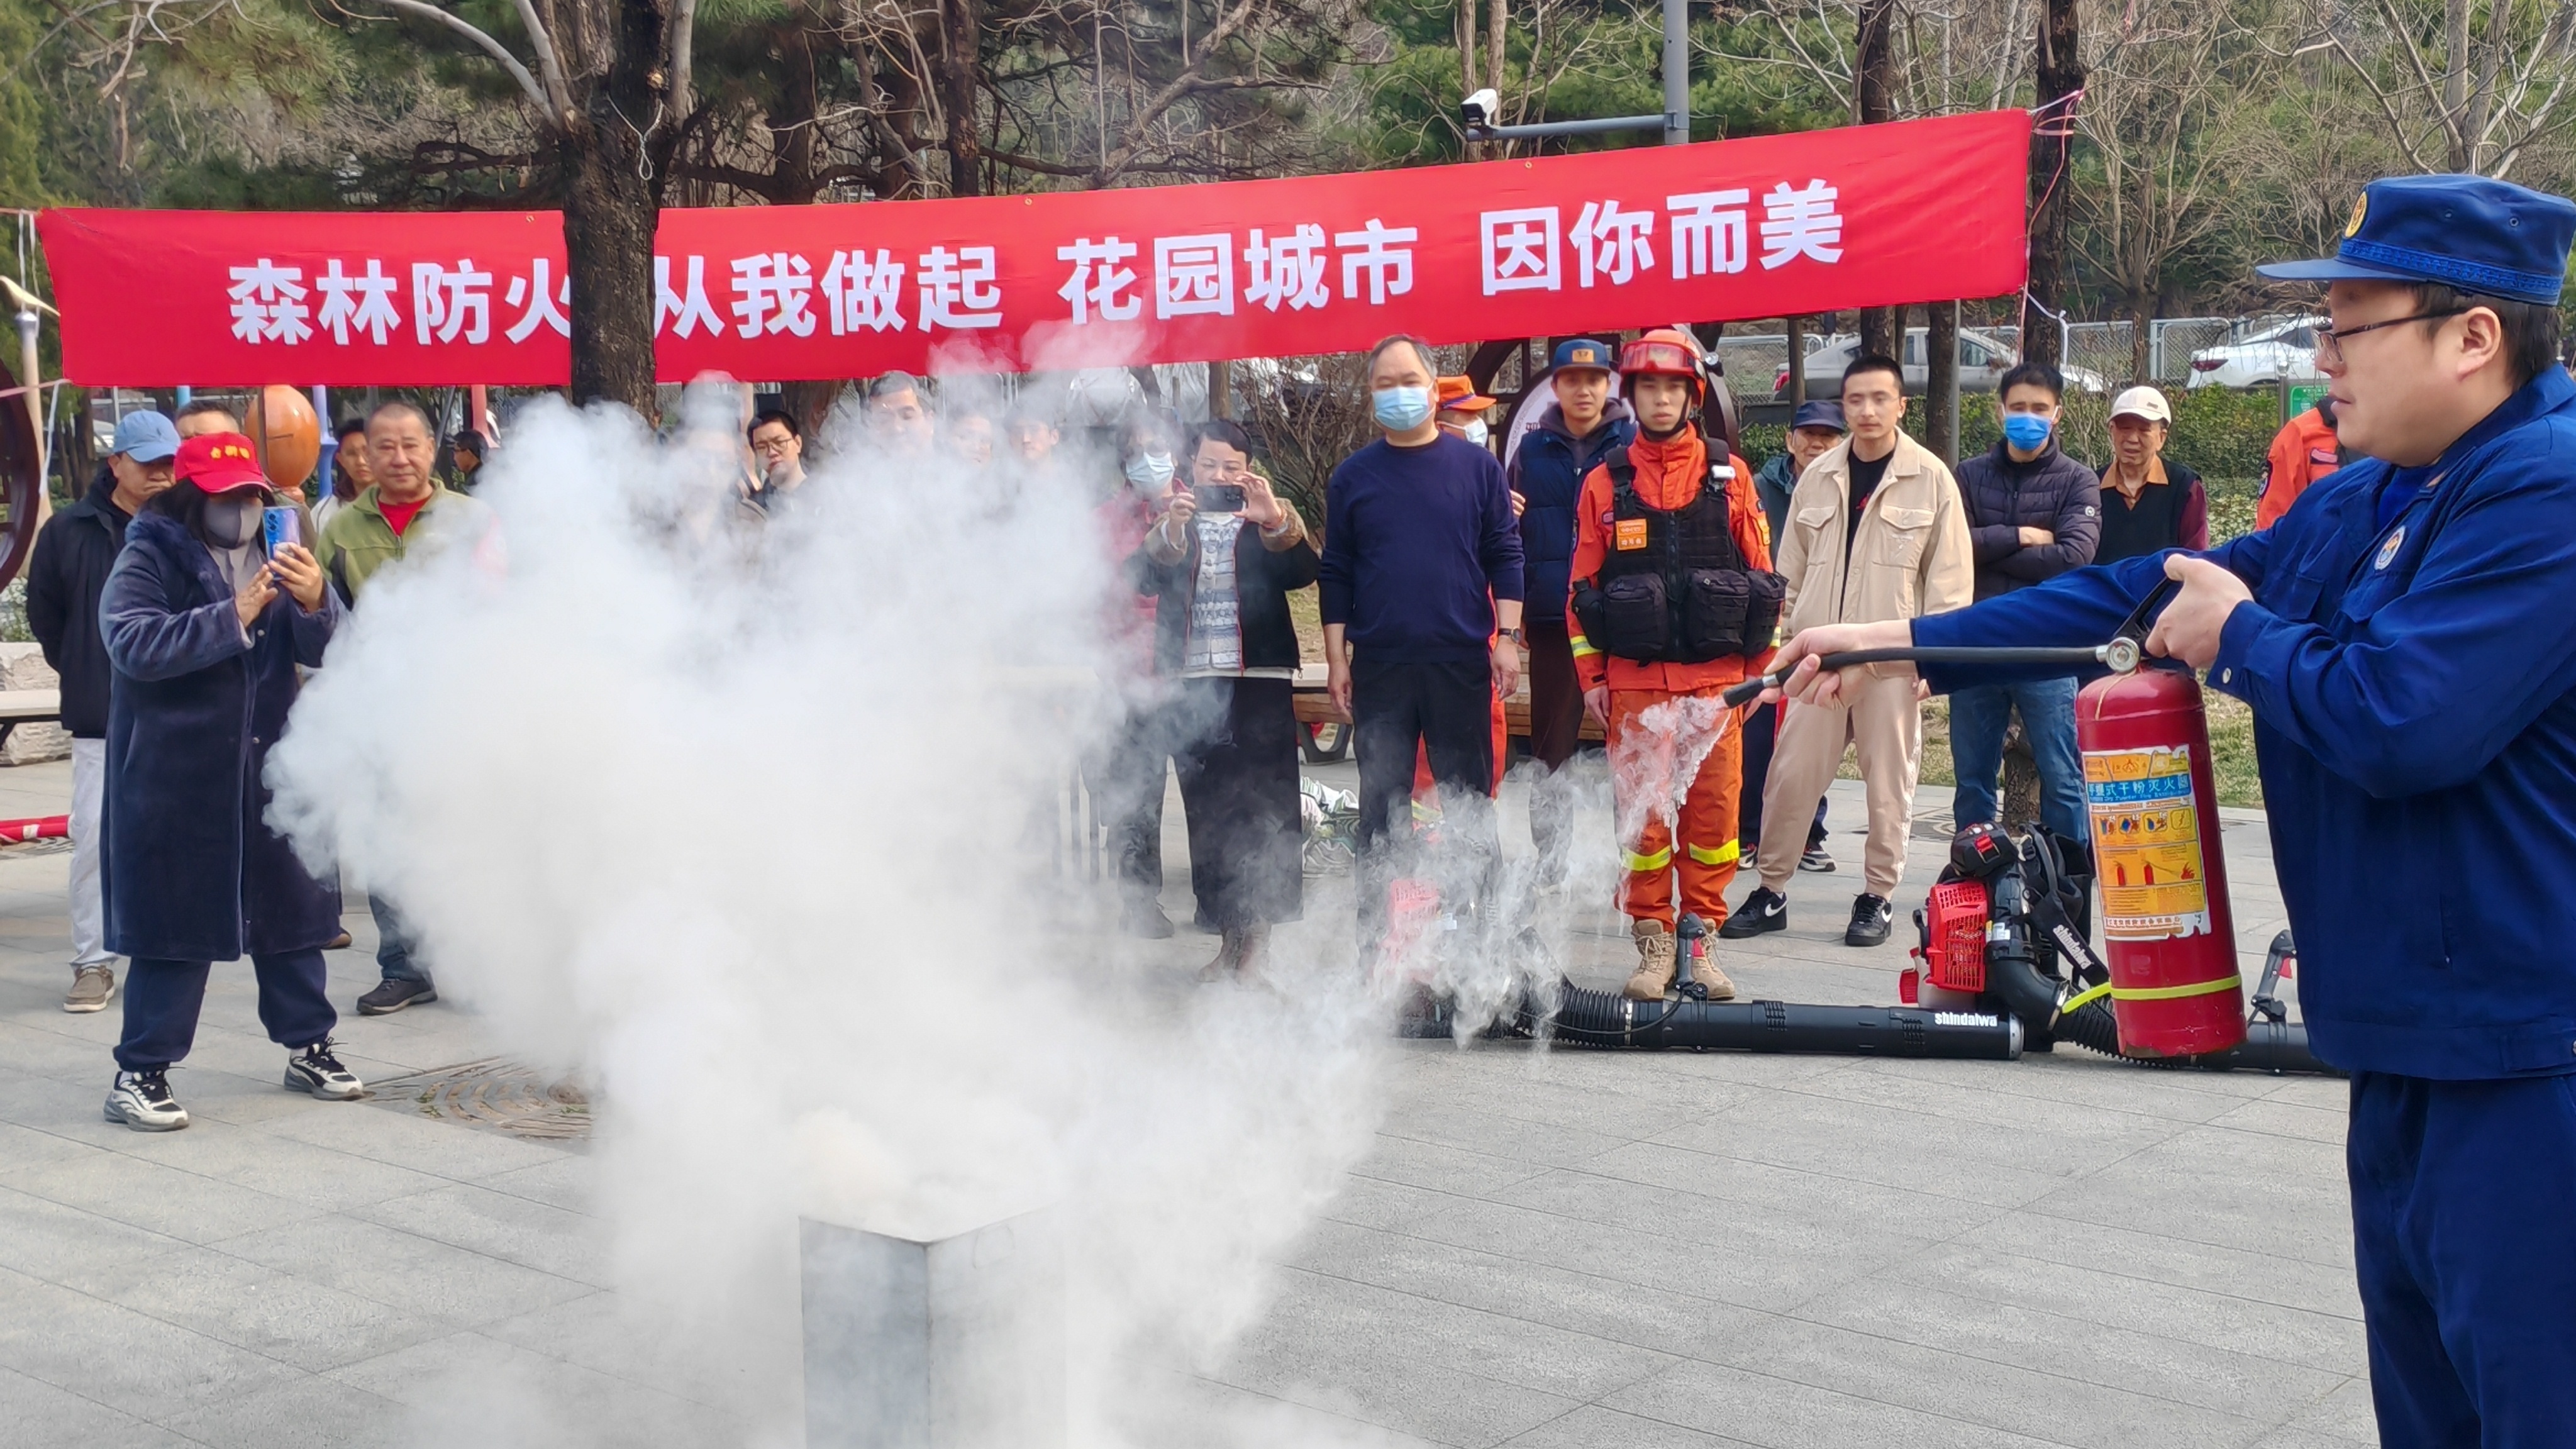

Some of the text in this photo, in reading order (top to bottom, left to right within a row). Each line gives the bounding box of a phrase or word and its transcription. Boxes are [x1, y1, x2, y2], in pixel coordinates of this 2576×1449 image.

[227, 178, 1843, 345] 森林防火 从我做起 花园城市 因你而美
[2053, 924, 2095, 969] shindaiwa
[1935, 1012, 1997, 1027] shindaiwa
